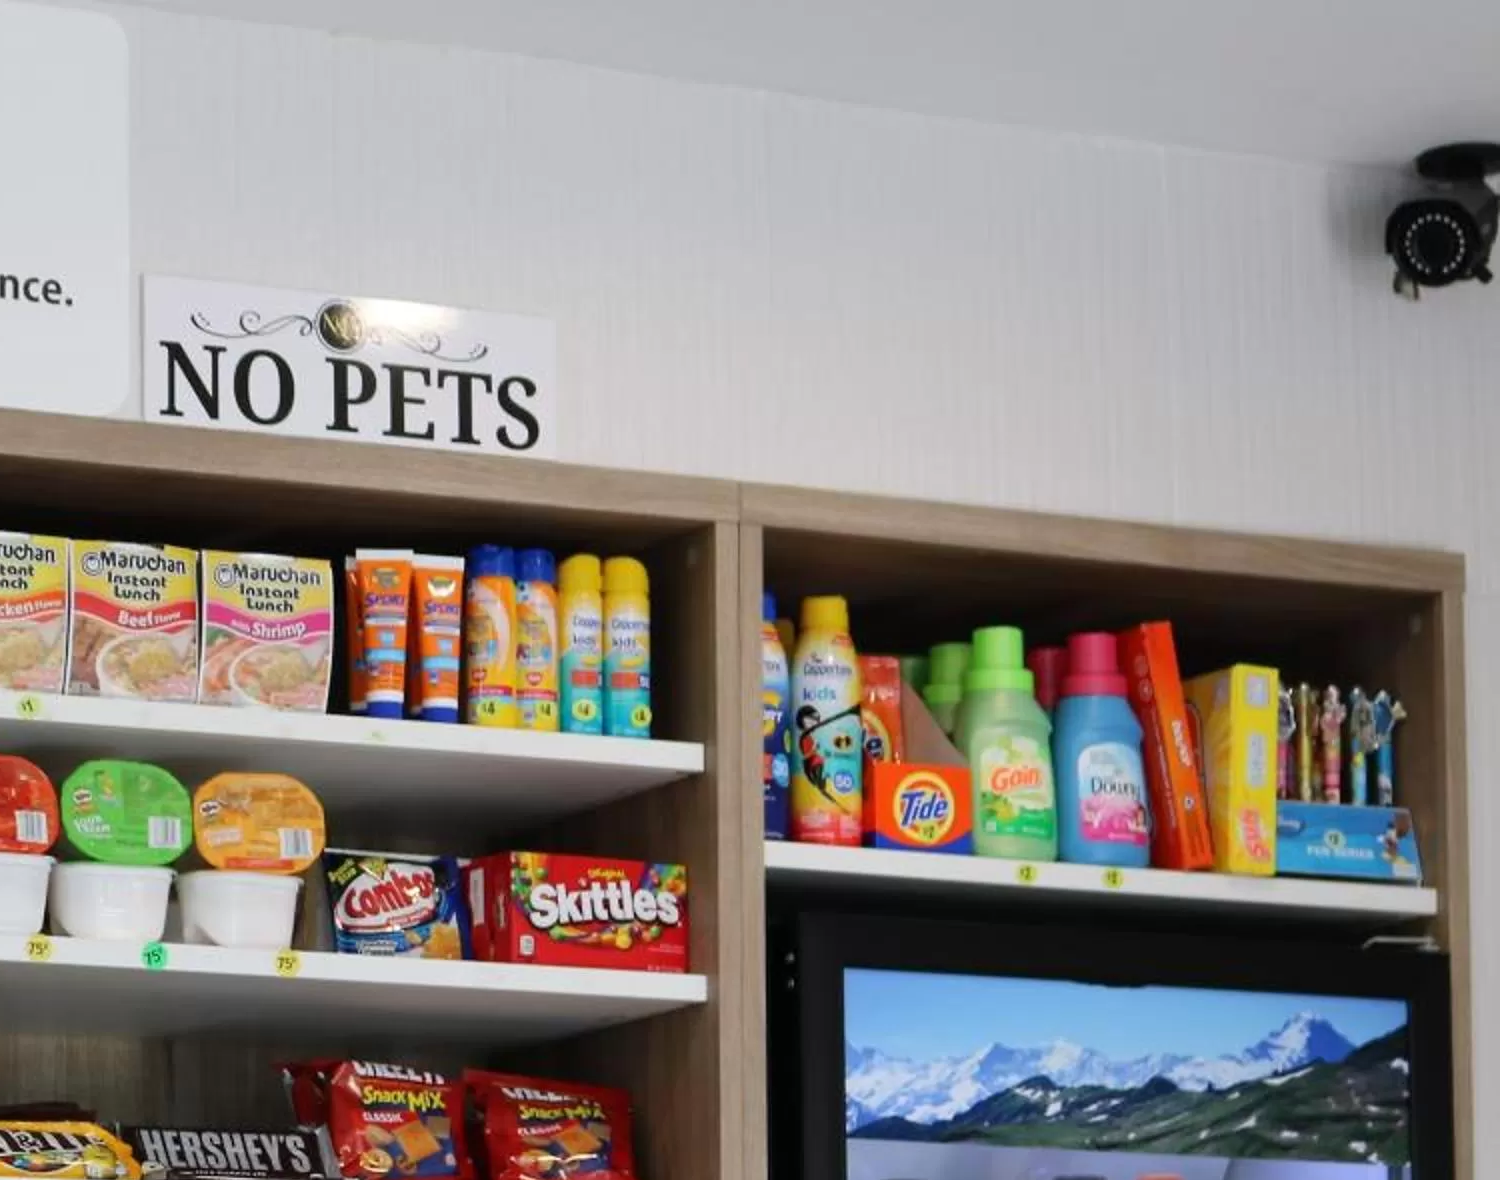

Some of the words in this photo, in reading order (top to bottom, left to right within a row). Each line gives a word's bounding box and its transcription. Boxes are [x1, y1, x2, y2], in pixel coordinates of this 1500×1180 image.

[158, 340, 297, 427] NO
[325, 355, 541, 451] PETS
[101, 550, 186, 575] Maruchan
[107, 572, 167, 590] Instant
[232, 563, 321, 586] Maruchan
[113, 585, 162, 602] Lunch
[239, 582, 301, 600] Instant
[246, 597, 294, 614] Lunch
[117, 608, 153, 627] Beef
[250, 618, 307, 640] Shrimp
[803, 687, 837, 703] kids
[989, 766, 1041, 793] Gain
[1090, 775, 1141, 800] Downy
[900, 793, 948, 826] Tide
[344, 870, 433, 918] Combos
[529, 882, 681, 928] Skittles
[362, 1085, 406, 1105] Snack
[518, 1104, 562, 1121] Snack
[139, 1128, 312, 1173] HERSHEY'S
